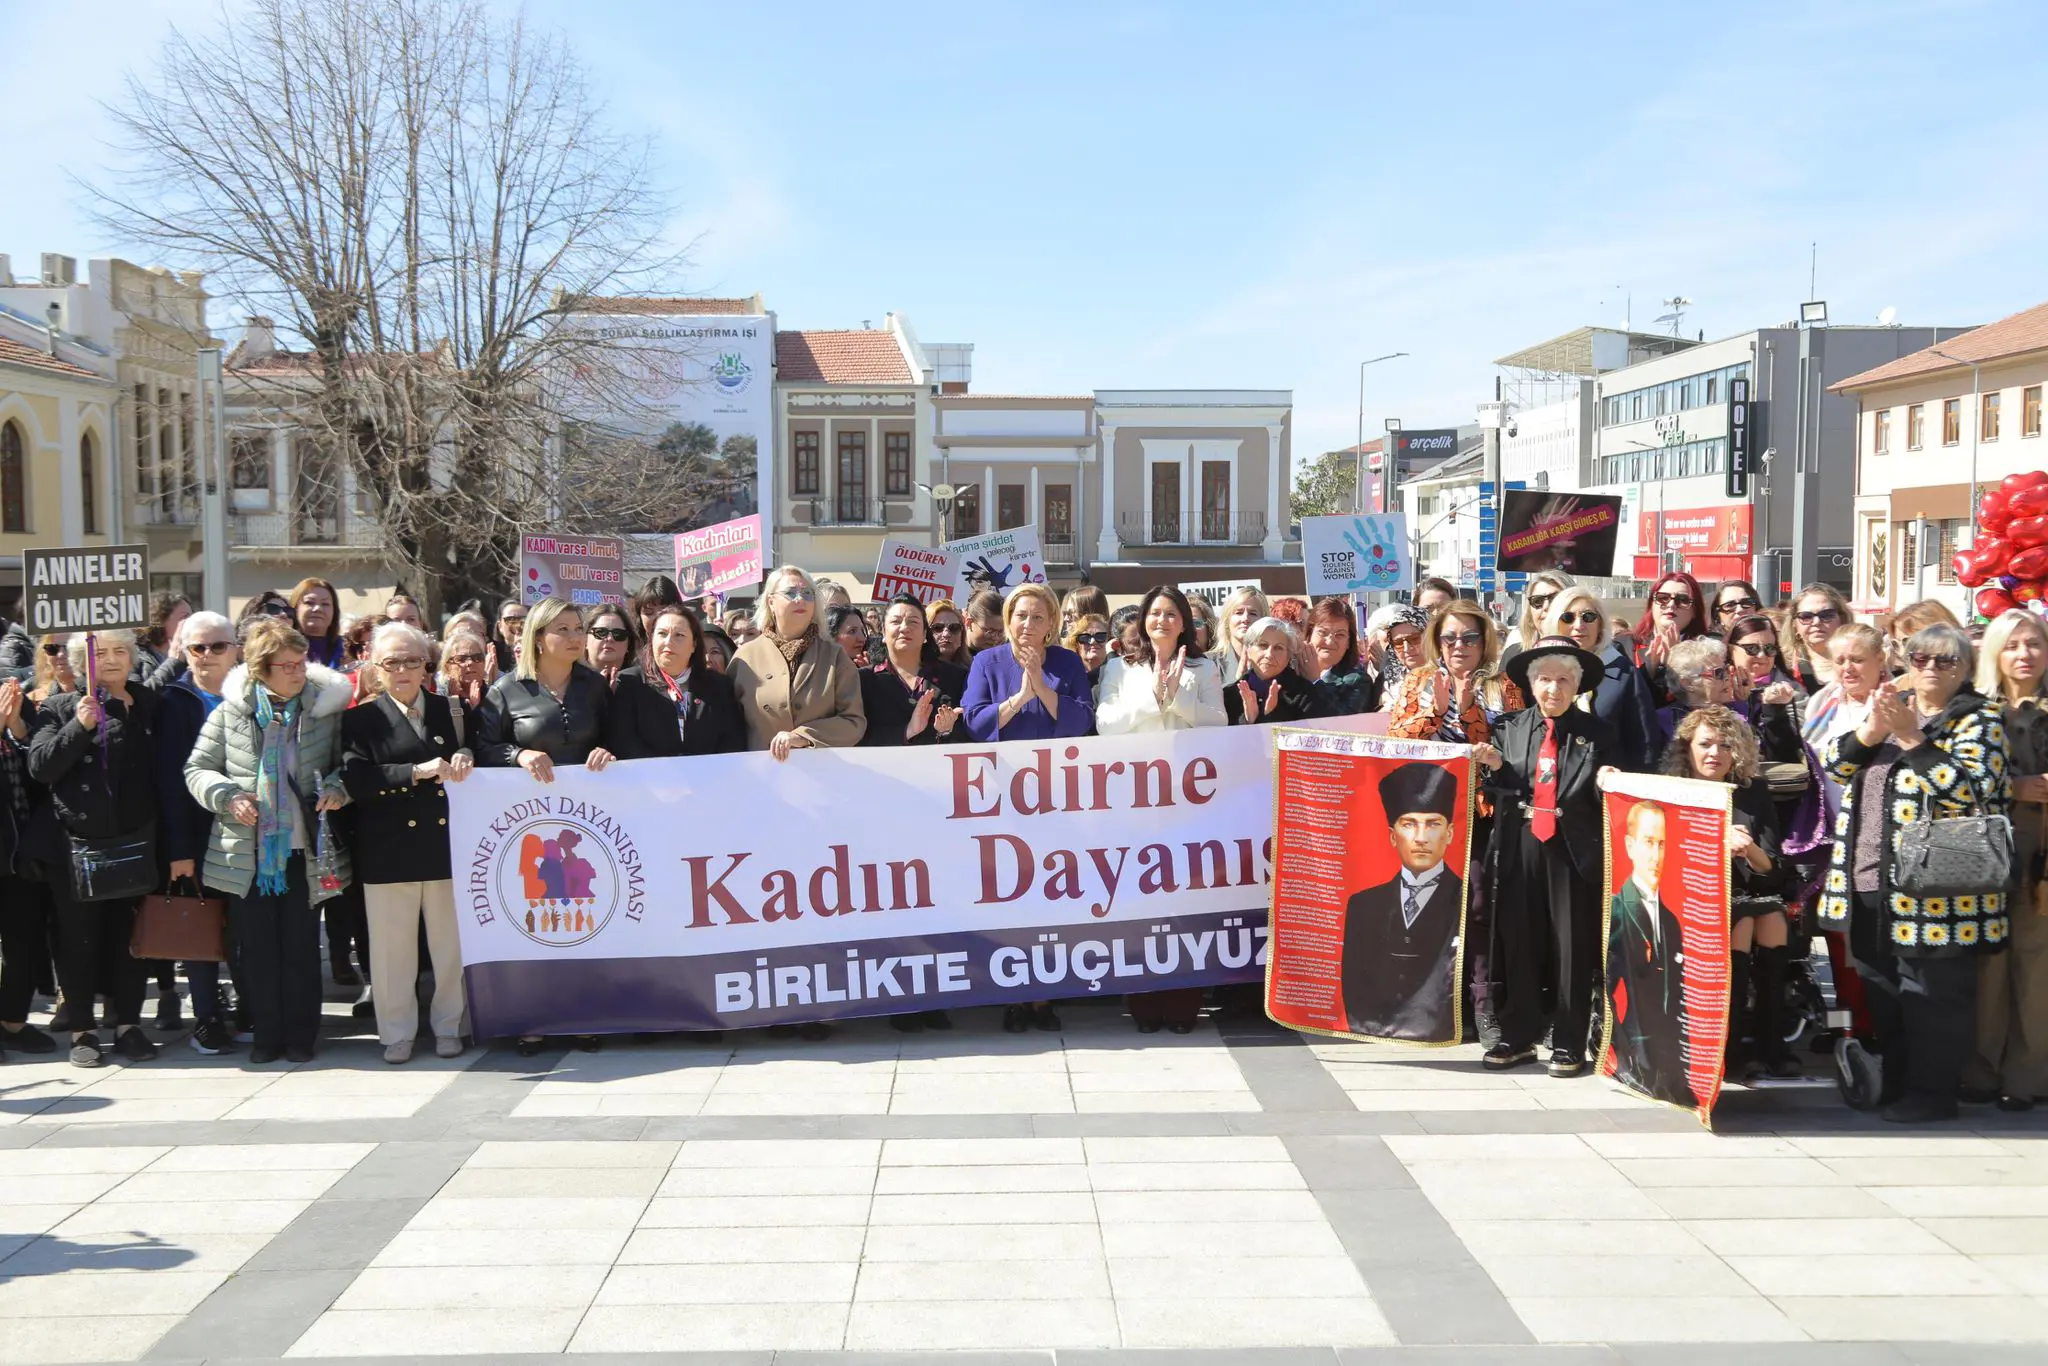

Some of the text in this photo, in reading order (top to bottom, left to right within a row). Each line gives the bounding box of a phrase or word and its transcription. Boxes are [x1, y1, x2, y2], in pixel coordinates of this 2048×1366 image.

[1409, 436, 1453, 451] arçelik
[1733, 381, 1745, 494] HOTEL
[681, 525, 753, 557] Kadınları
[1506, 529, 1550, 552] KARANLIĞA
[1573, 513, 1599, 531] GÜNEŞ
[1599, 510, 1610, 521] OL
[526, 537, 620, 560] KADIN varsa Umut,
[894, 545, 947, 566] ÖLDÜREN
[986, 545, 1017, 558] geleceği
[1321, 552, 1355, 563] STOP
[33, 553, 143, 586] ANNELER
[560, 563, 620, 582] UMUT varsa
[703, 558, 759, 590] acizdir
[893, 564, 937, 581] SEVGİYE
[1323, 572, 1356, 580] WOMEN
[34, 589, 143, 629] ÖLMESİN
[944, 745, 1218, 820] Edirne
[467, 796, 646, 927] EDİRNE KADIN DAYANIŞMASI
[680, 844, 935, 929] Kadın
[714, 917, 1271, 1013] BİRLİKTE GÜÇLÜYÜZ
